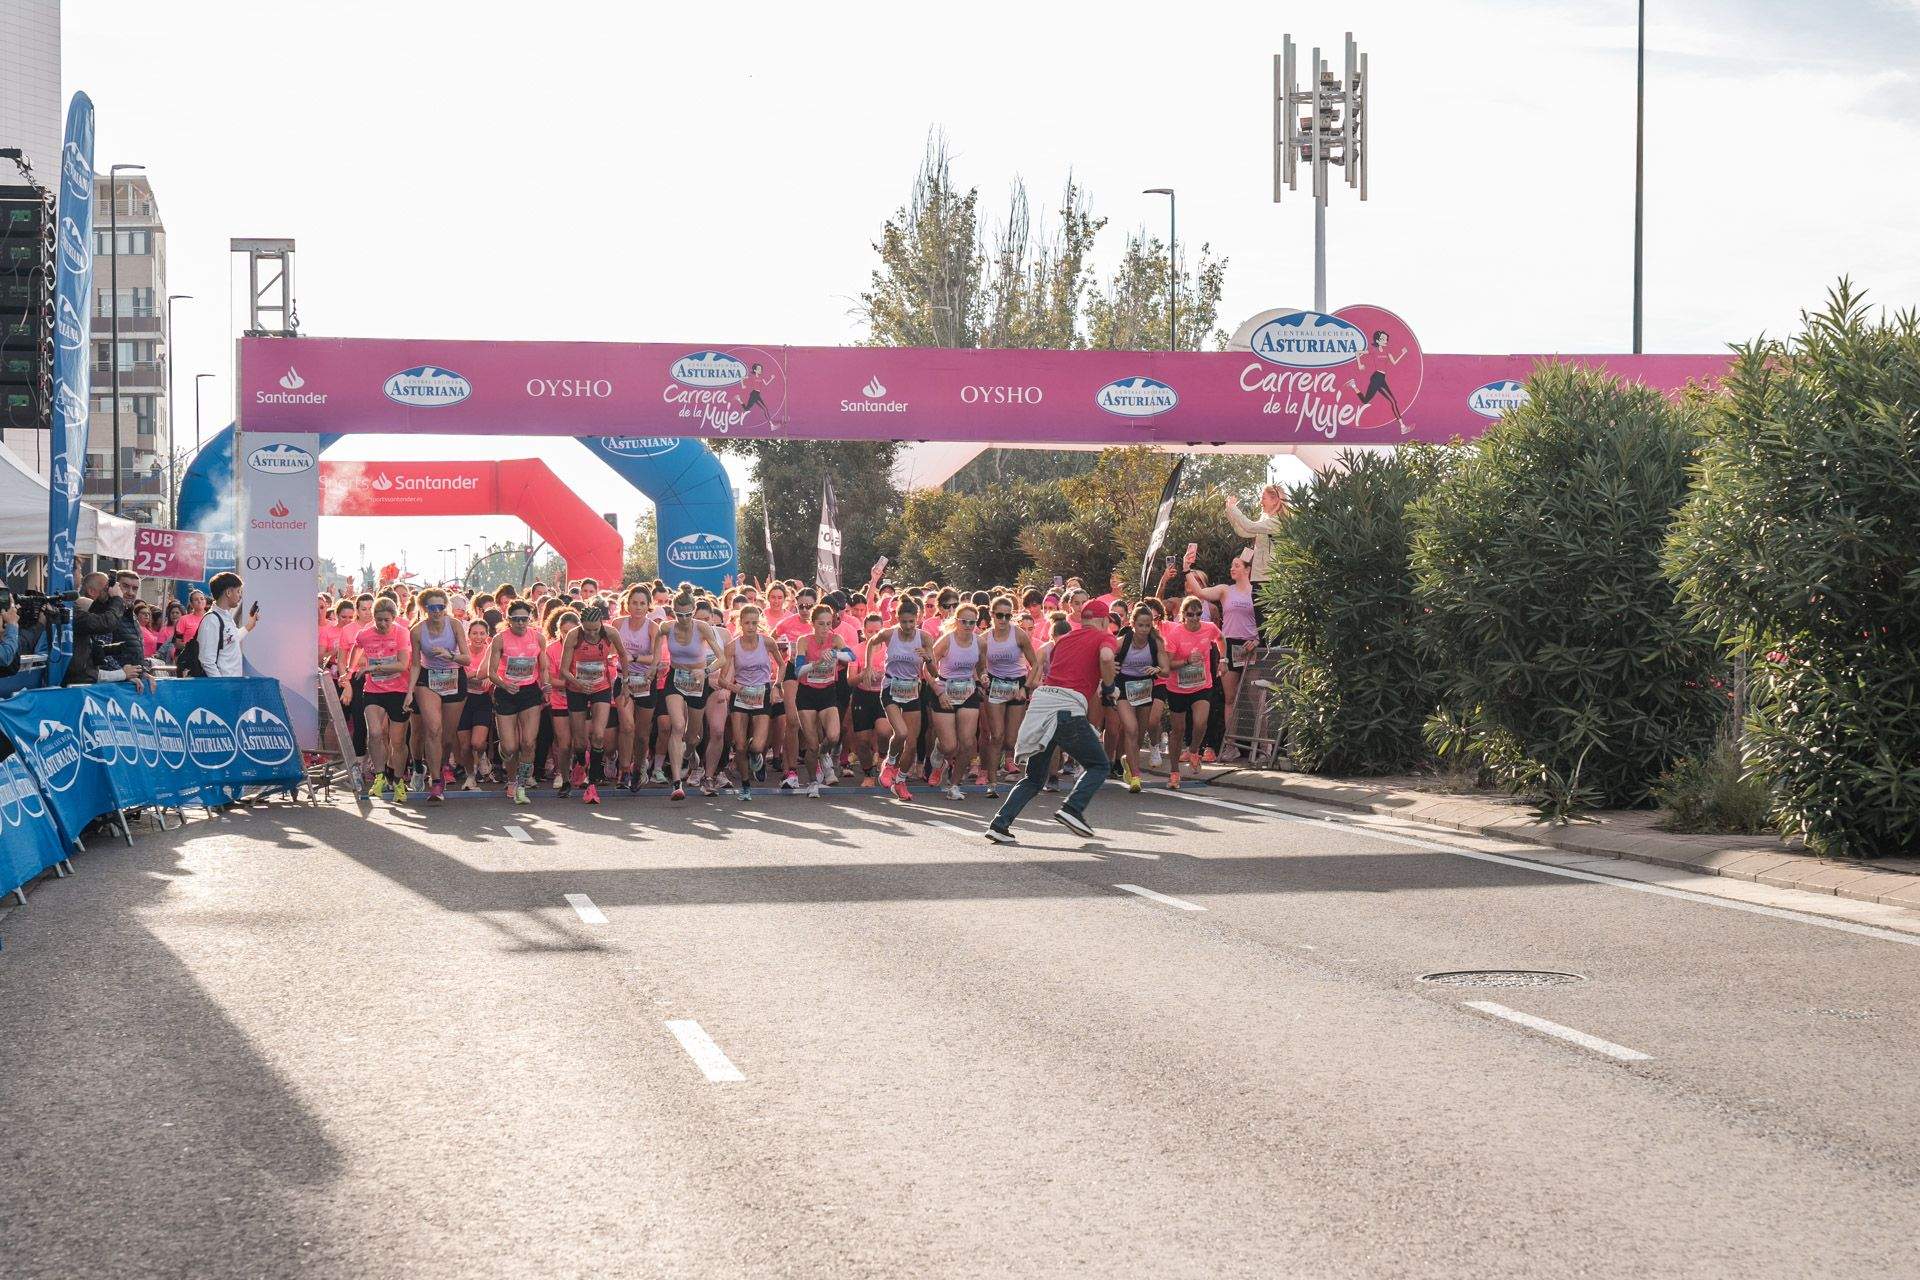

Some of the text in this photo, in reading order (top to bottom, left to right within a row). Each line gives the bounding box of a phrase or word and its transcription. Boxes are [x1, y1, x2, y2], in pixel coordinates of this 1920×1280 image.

[1260, 331, 1358, 354] ASTURIANA
[676, 363, 742, 379] ASTURIANA
[1239, 362, 1337, 393] Carrera
[390, 380, 466, 397] ASTURIANA
[526, 378, 612, 398] OYSHO
[663, 384, 727, 404] Carrera
[960, 385, 1043, 404] OYSHO
[256, 391, 328, 405] Santander
[1102, 391, 1172, 406] ASTURIANA
[1474, 394, 1519, 409] ASTURI
[840, 400, 908, 413] Santander
[679, 402, 751, 434] de la Mujer
[1263, 391, 1372, 439] de la Mujer
[608, 437, 675, 449] ASTURIANA
[253, 454, 310, 468] ASTURIANA
[395, 475, 479, 491] Santander
[251, 518, 308, 530] Santander
[140, 531, 174, 548] SUB
[671, 547, 730, 560] ASTURIANA
[246, 555, 314, 571] OYSHO
[190, 729, 236, 753] ASTURIANA
[240, 727, 292, 751] ASTURIANA
